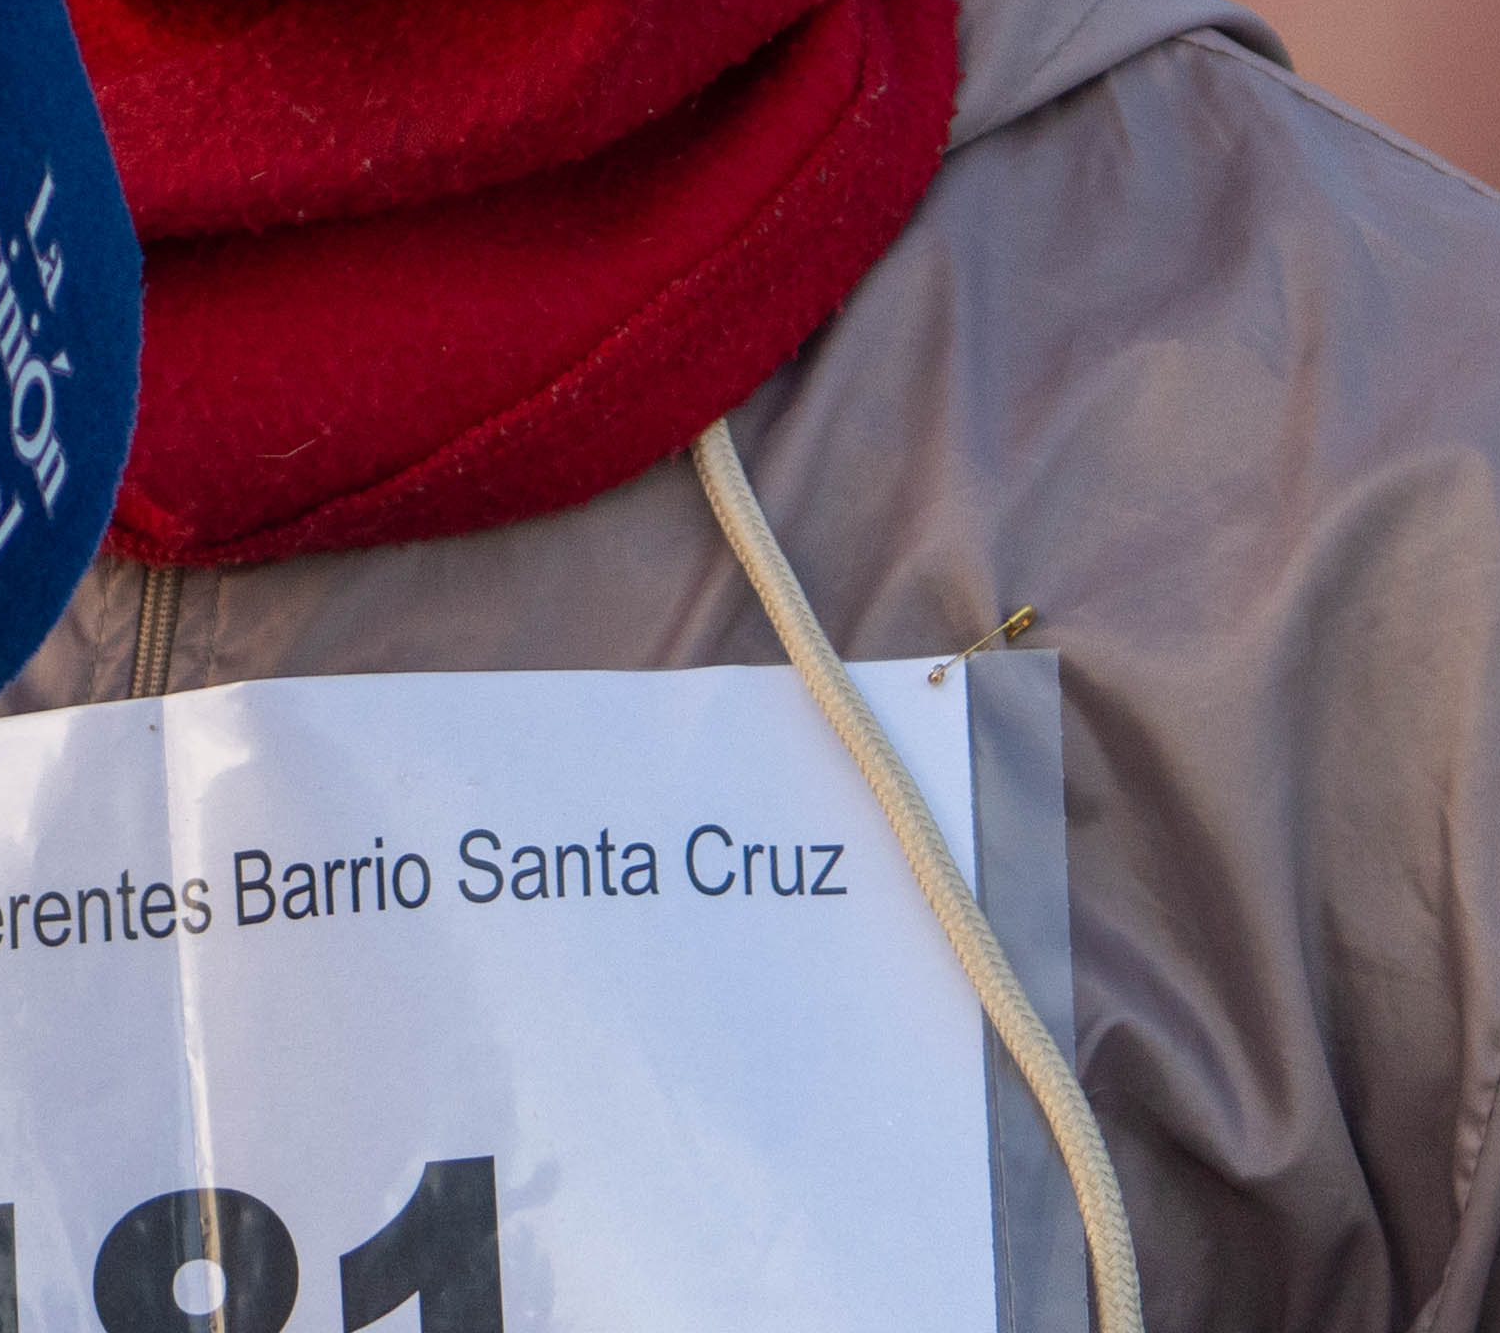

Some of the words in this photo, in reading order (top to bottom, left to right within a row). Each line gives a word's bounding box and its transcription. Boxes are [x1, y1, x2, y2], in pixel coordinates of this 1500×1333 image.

[26, 163, 64, 311] La
[232, 836, 433, 927] Barrio
[457, 827, 660, 903] Santa
[684, 824, 848, 897] Cruz
